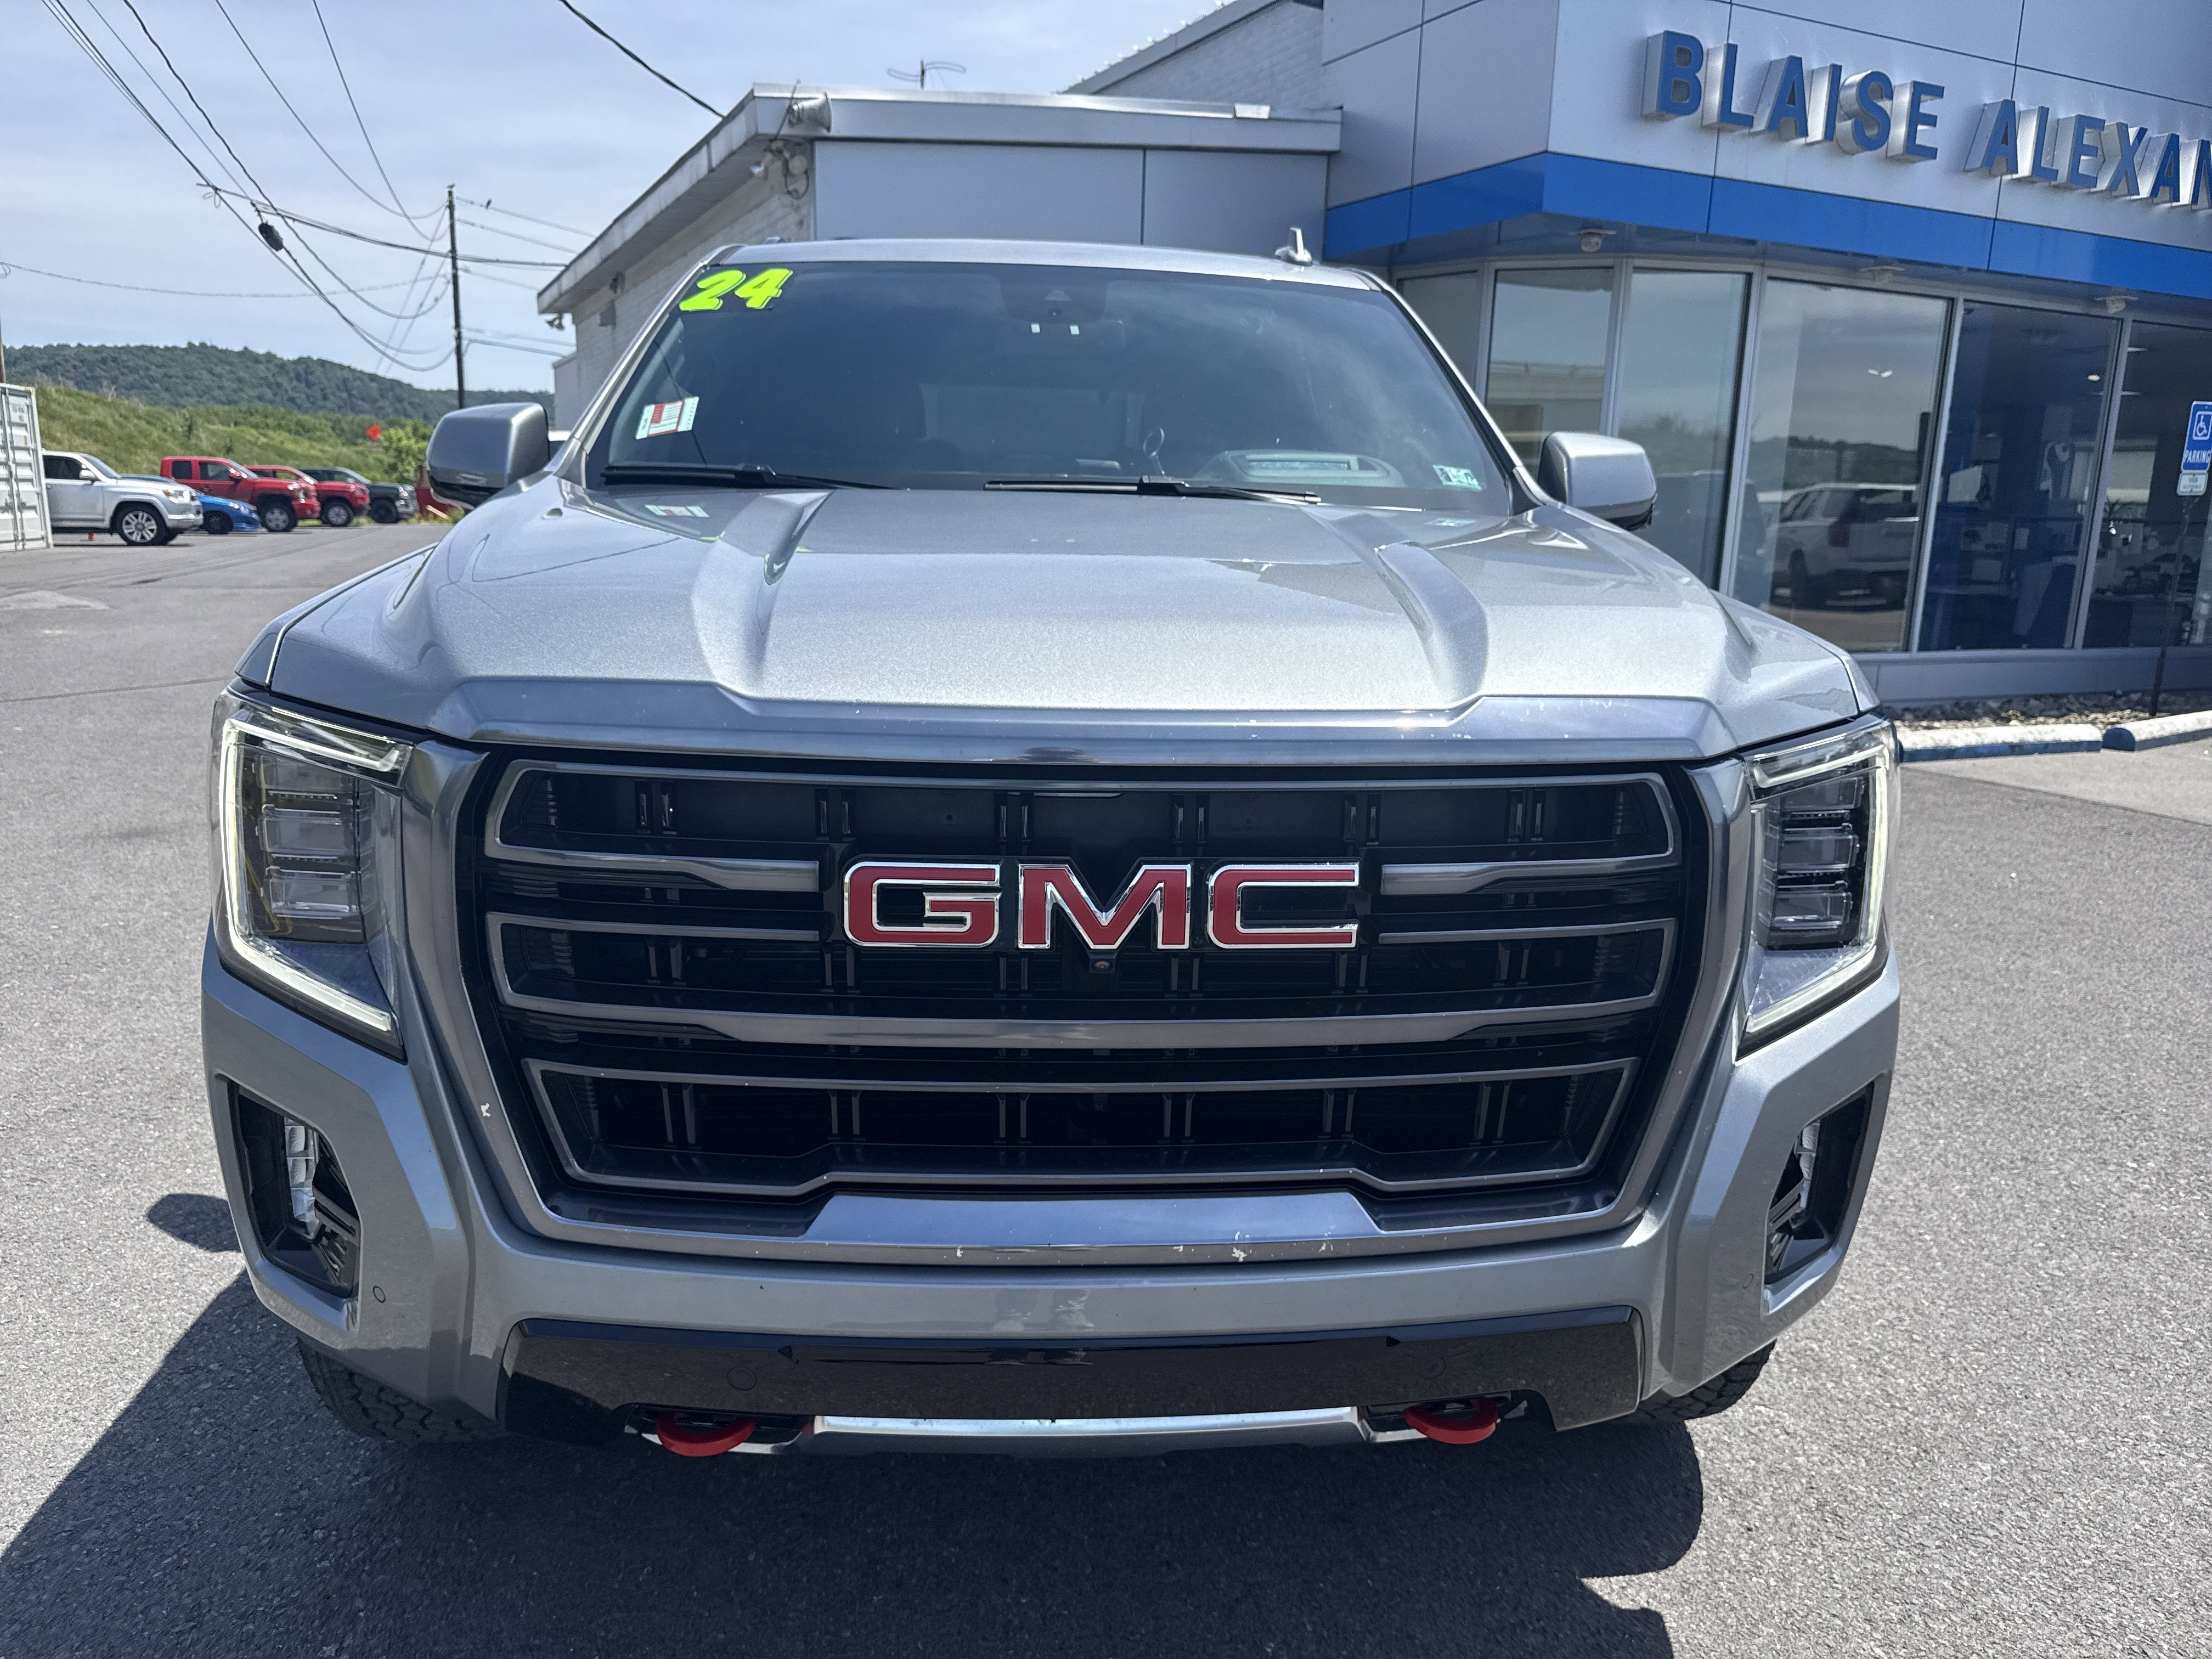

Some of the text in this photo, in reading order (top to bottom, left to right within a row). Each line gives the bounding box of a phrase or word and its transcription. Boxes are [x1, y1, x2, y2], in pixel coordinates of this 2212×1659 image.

[1654, 30, 1945, 162] BLAISE
[679, 267, 793, 311] 24
[2183, 450, 2211, 463] PARKING
[844, 861, 1361, 950] GMC
